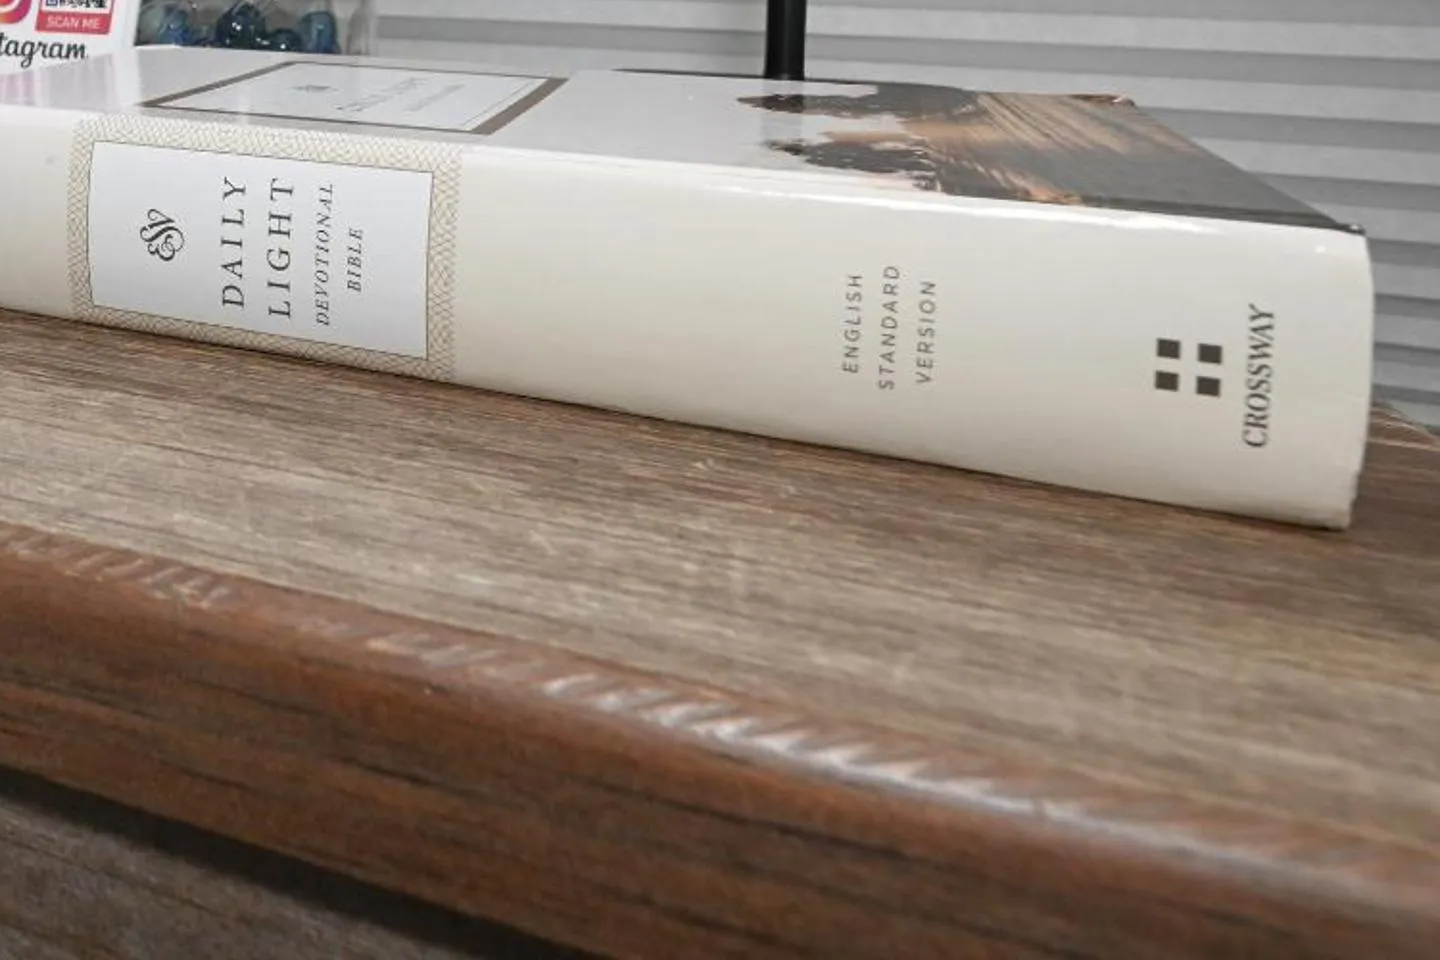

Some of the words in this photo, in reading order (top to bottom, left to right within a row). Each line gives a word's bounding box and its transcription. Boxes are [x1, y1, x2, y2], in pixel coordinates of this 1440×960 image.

[46, 16, 80, 29] SCAN
[83, 18, 100, 30] ME
[221, 176, 247, 309] DAILY
[266, 177, 294, 319] LIGHT
[315, 183, 334, 327] DEVOTIONAL
[347, 227, 364, 293] BIBLE
[842, 273, 862, 374] ENGLISH
[878, 264, 900, 391] STANDARD
[916, 281, 937, 385] VERSION
[1242, 303, 1276, 448] CROSSWAY
